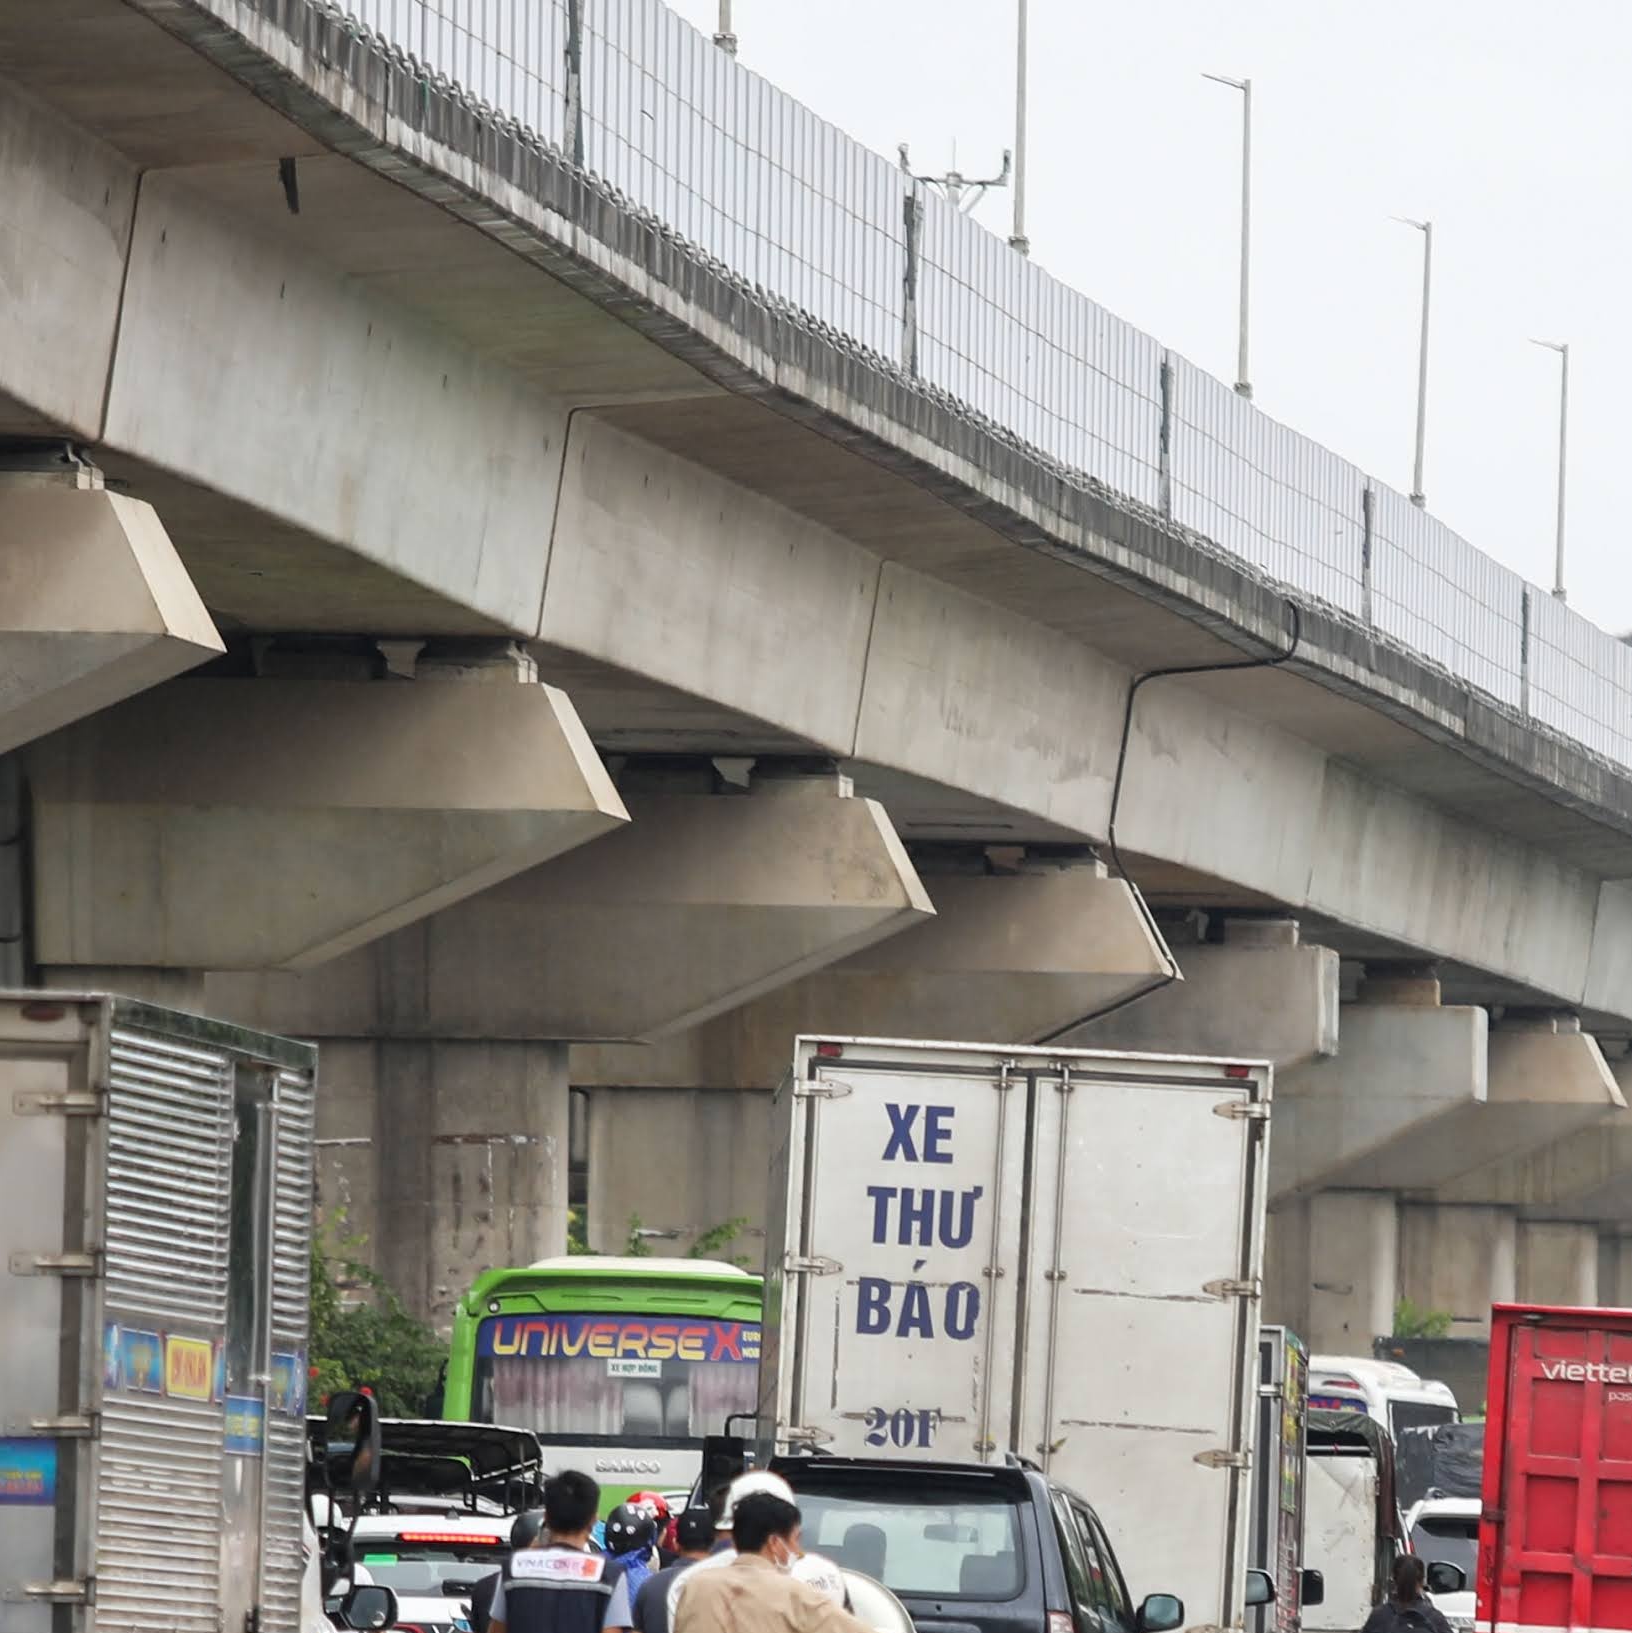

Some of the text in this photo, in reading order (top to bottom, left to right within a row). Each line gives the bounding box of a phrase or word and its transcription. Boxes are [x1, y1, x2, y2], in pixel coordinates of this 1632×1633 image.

[881, 1103, 955, 1164] XE
[867, 1185, 983, 1249] THƯ
[855, 1259, 980, 1341] BÁO
[595, 1459, 661, 1474] SAMCO
